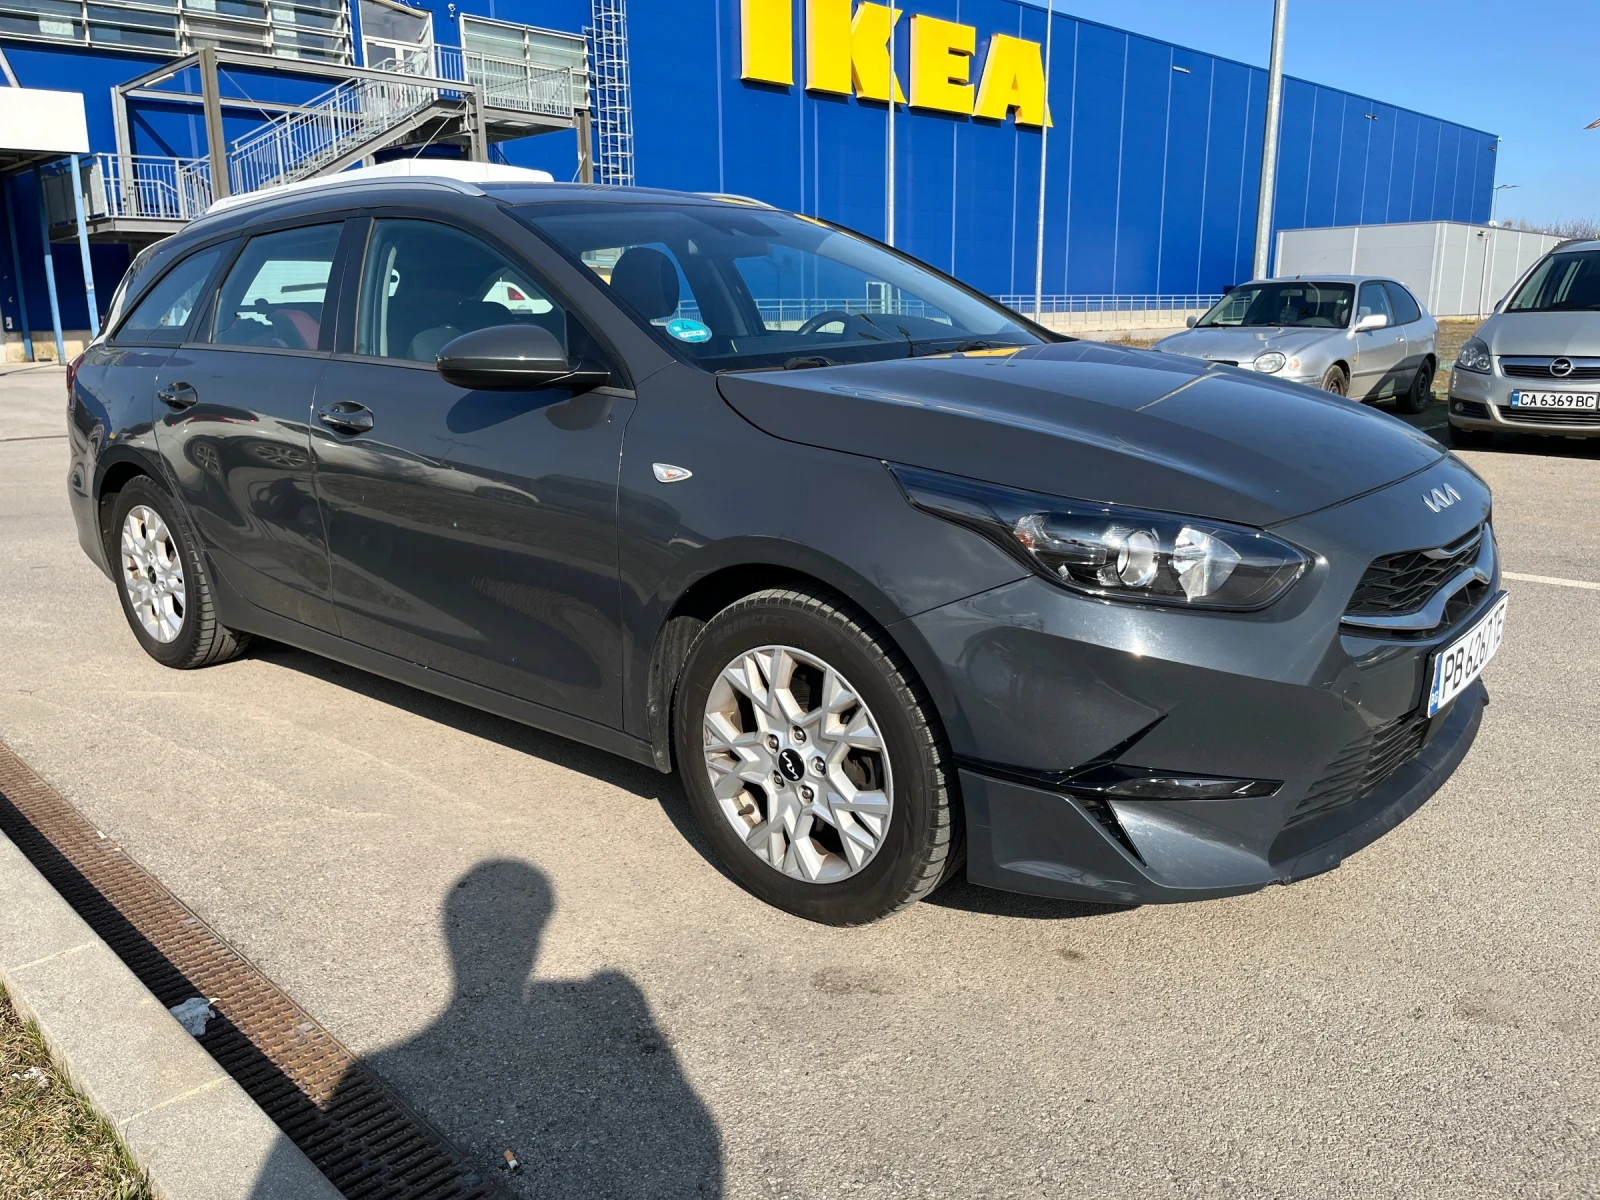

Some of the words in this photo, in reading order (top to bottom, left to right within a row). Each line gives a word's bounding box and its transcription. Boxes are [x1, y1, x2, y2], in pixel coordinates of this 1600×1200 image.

[740, 0, 1053, 128] IKEA
[1520, 393, 1537, 406] CA
[1540, 394, 1574, 407] 6369
[1576, 395, 1595, 408] BC
[1442, 646, 1465, 700] PB
[1465, 617, 1493, 679] 6267
